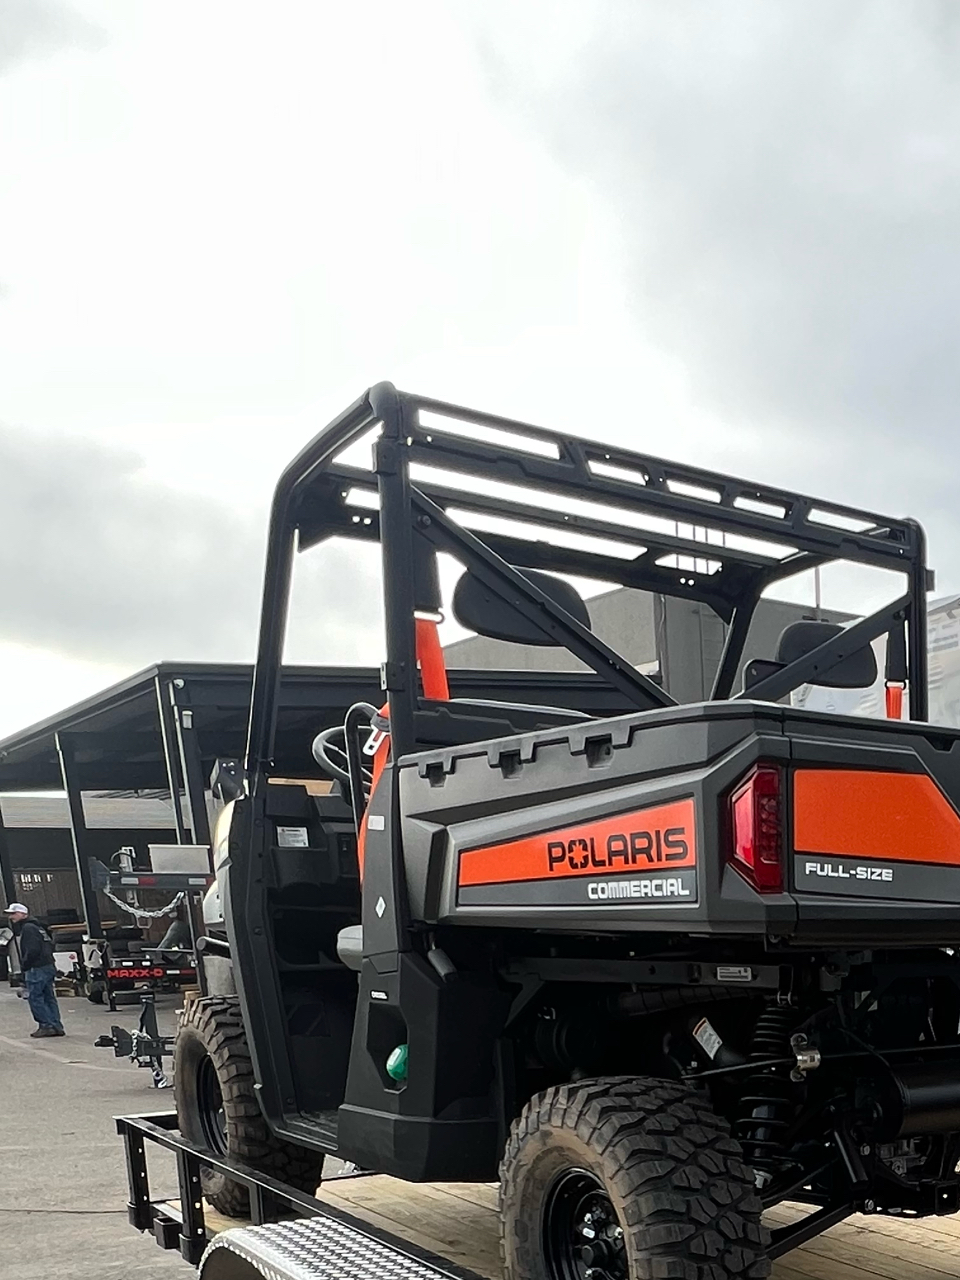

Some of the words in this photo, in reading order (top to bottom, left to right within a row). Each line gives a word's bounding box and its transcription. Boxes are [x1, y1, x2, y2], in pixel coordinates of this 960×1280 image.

[547, 827, 689, 872] POLARIS
[805, 862, 893, 881] FULL-SIZE
[587, 878, 690, 900] COMMERCIAL
[106, 968, 163, 978] MAXX-D
